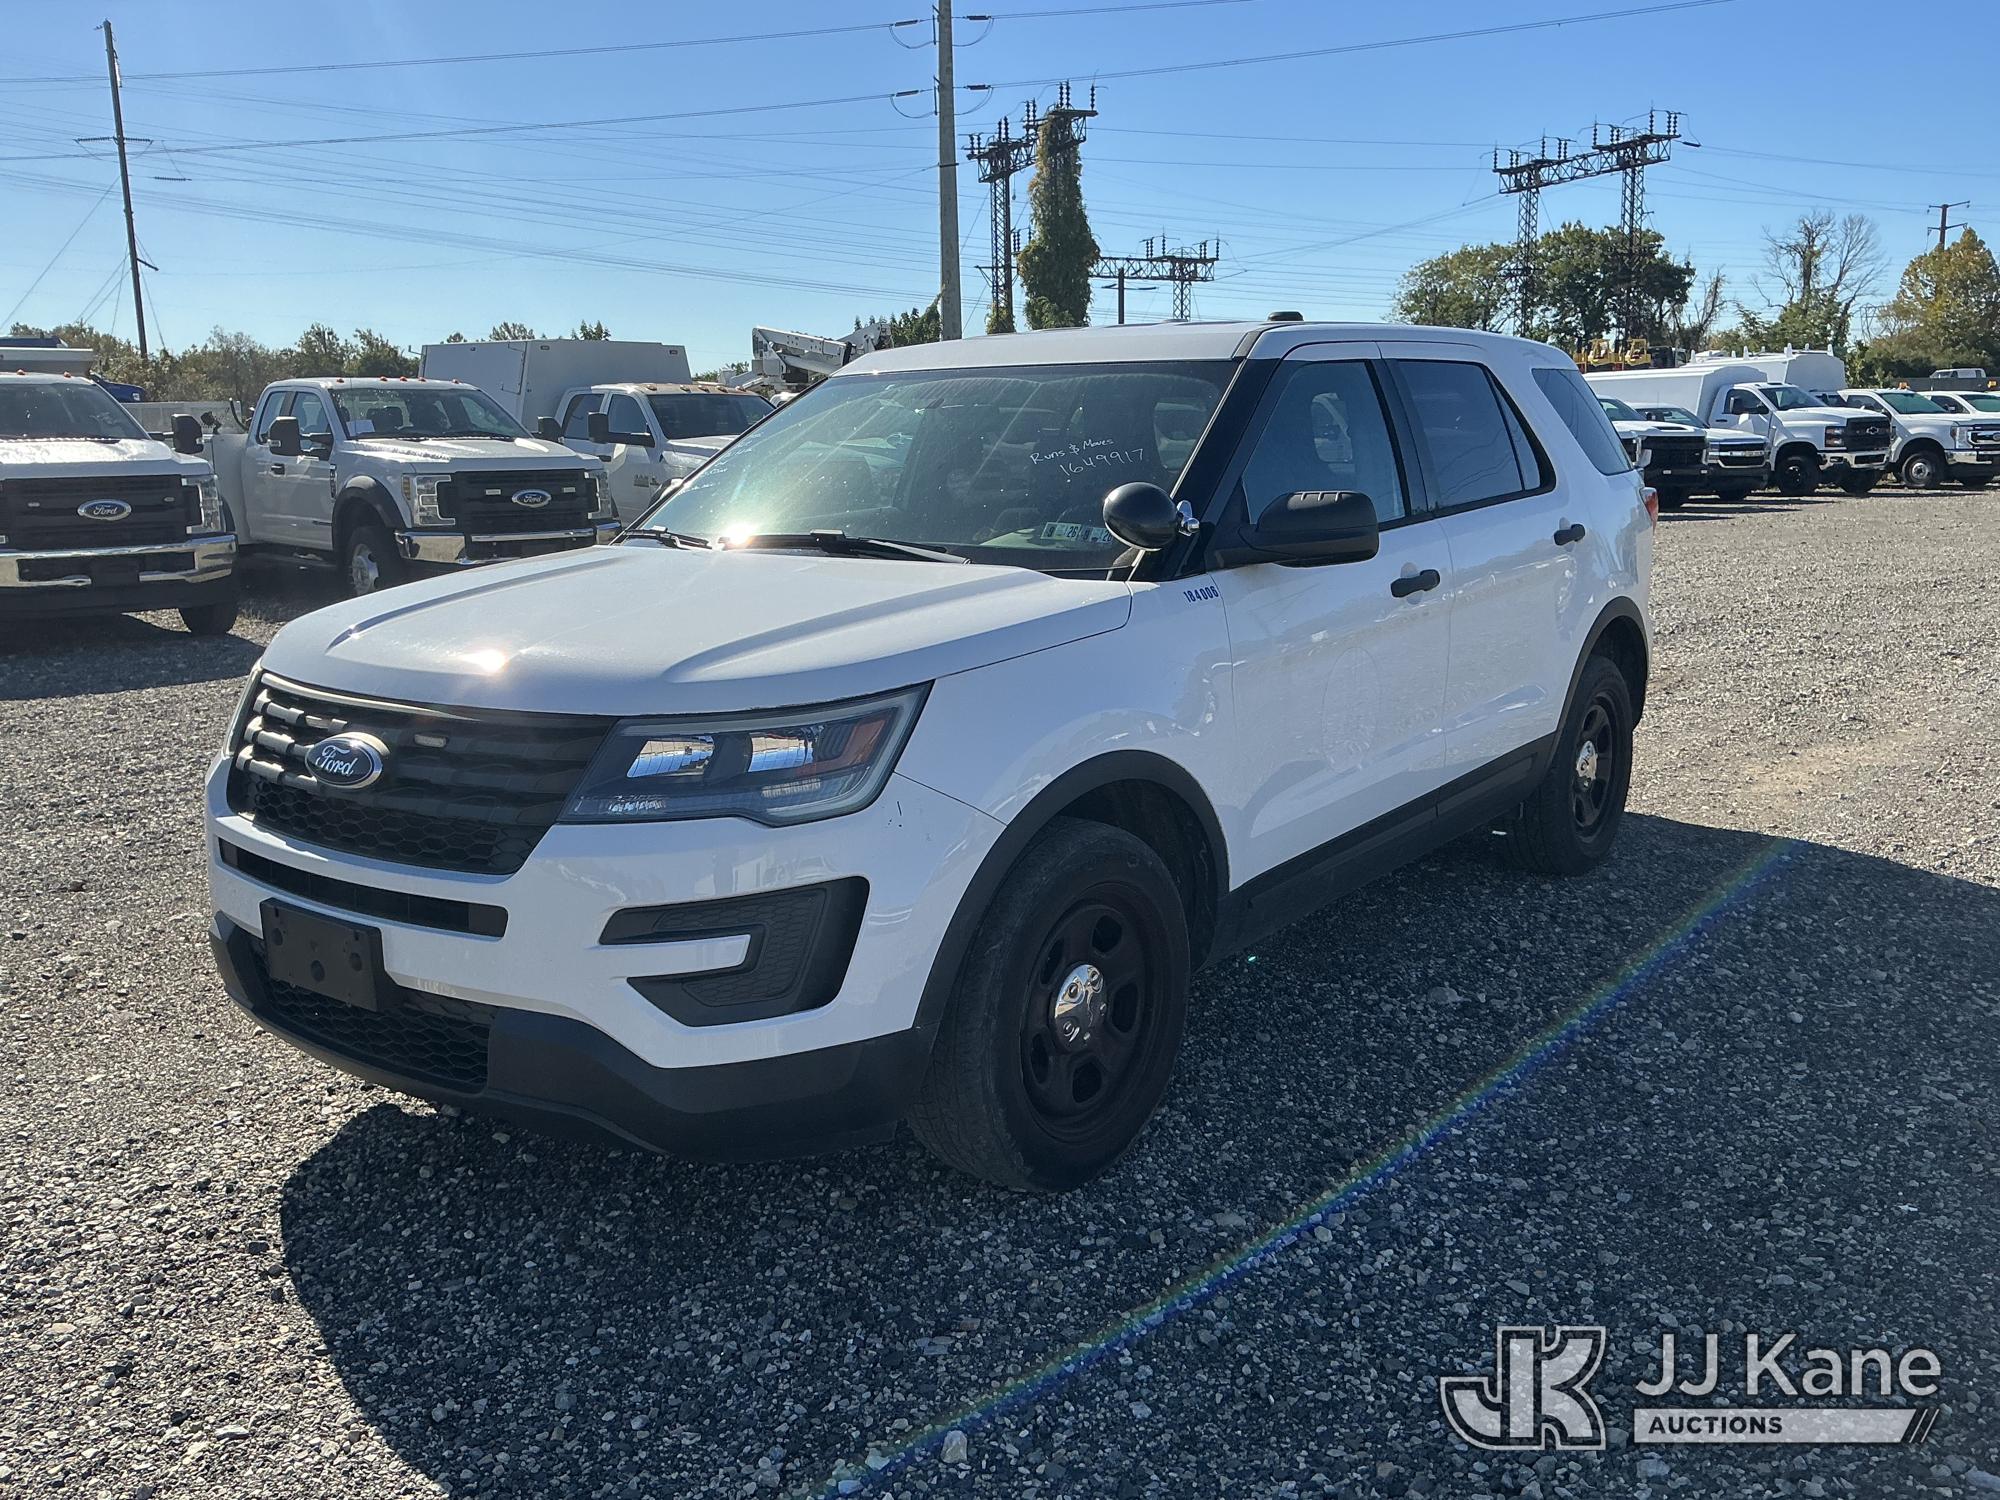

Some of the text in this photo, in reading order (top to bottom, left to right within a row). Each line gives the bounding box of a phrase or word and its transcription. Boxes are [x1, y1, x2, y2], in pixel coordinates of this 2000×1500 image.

[1030, 450, 1065, 464] Runs
[1083, 439, 1114, 449] Moves
[1060, 448, 1143, 476] 1649917
[93, 505, 118, 515] Ford
[1183, 585, 1219, 603] 184006
[315, 745, 358, 777] Ford
